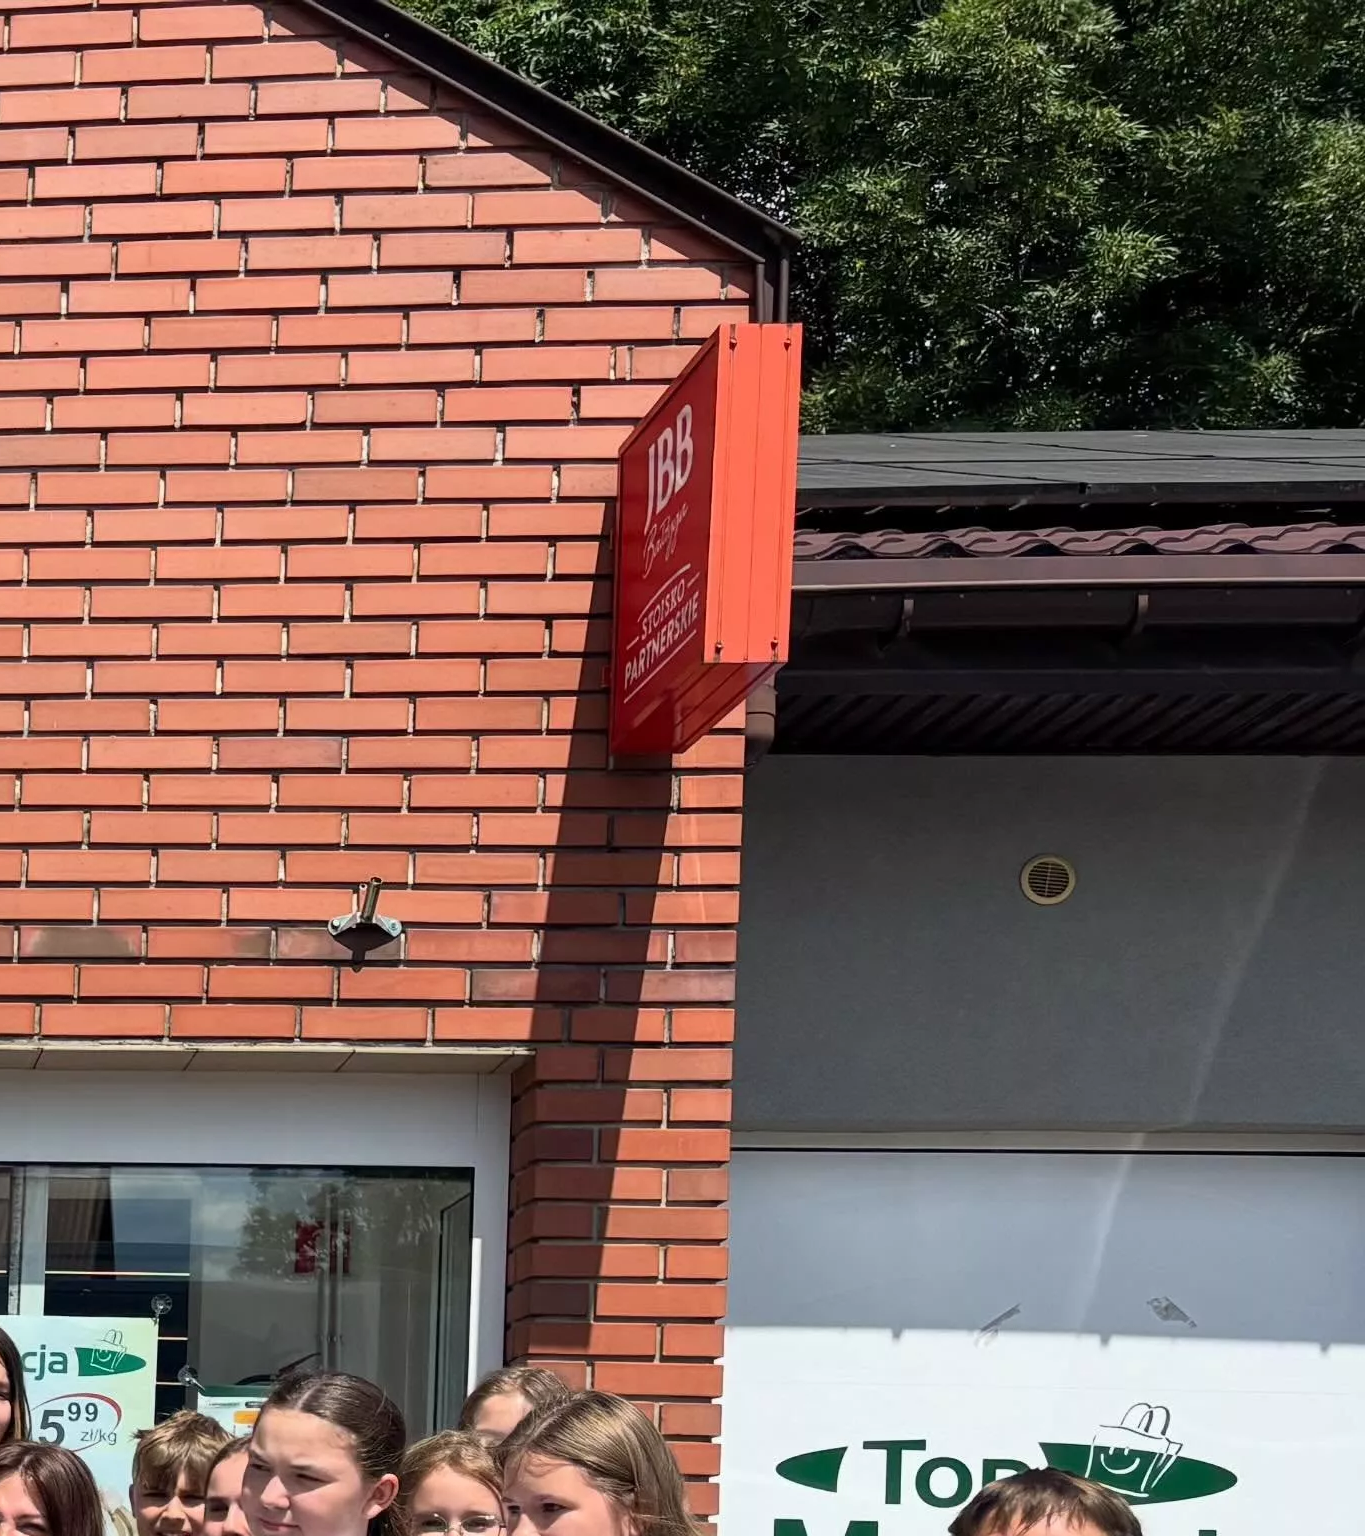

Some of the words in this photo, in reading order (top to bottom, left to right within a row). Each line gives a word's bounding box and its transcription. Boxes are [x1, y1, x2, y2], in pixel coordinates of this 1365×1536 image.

[644, 403, 695, 532] JBB
[624, 591, 699, 691] PARTNERSKIE
[641, 578, 685, 641] STOISKO
